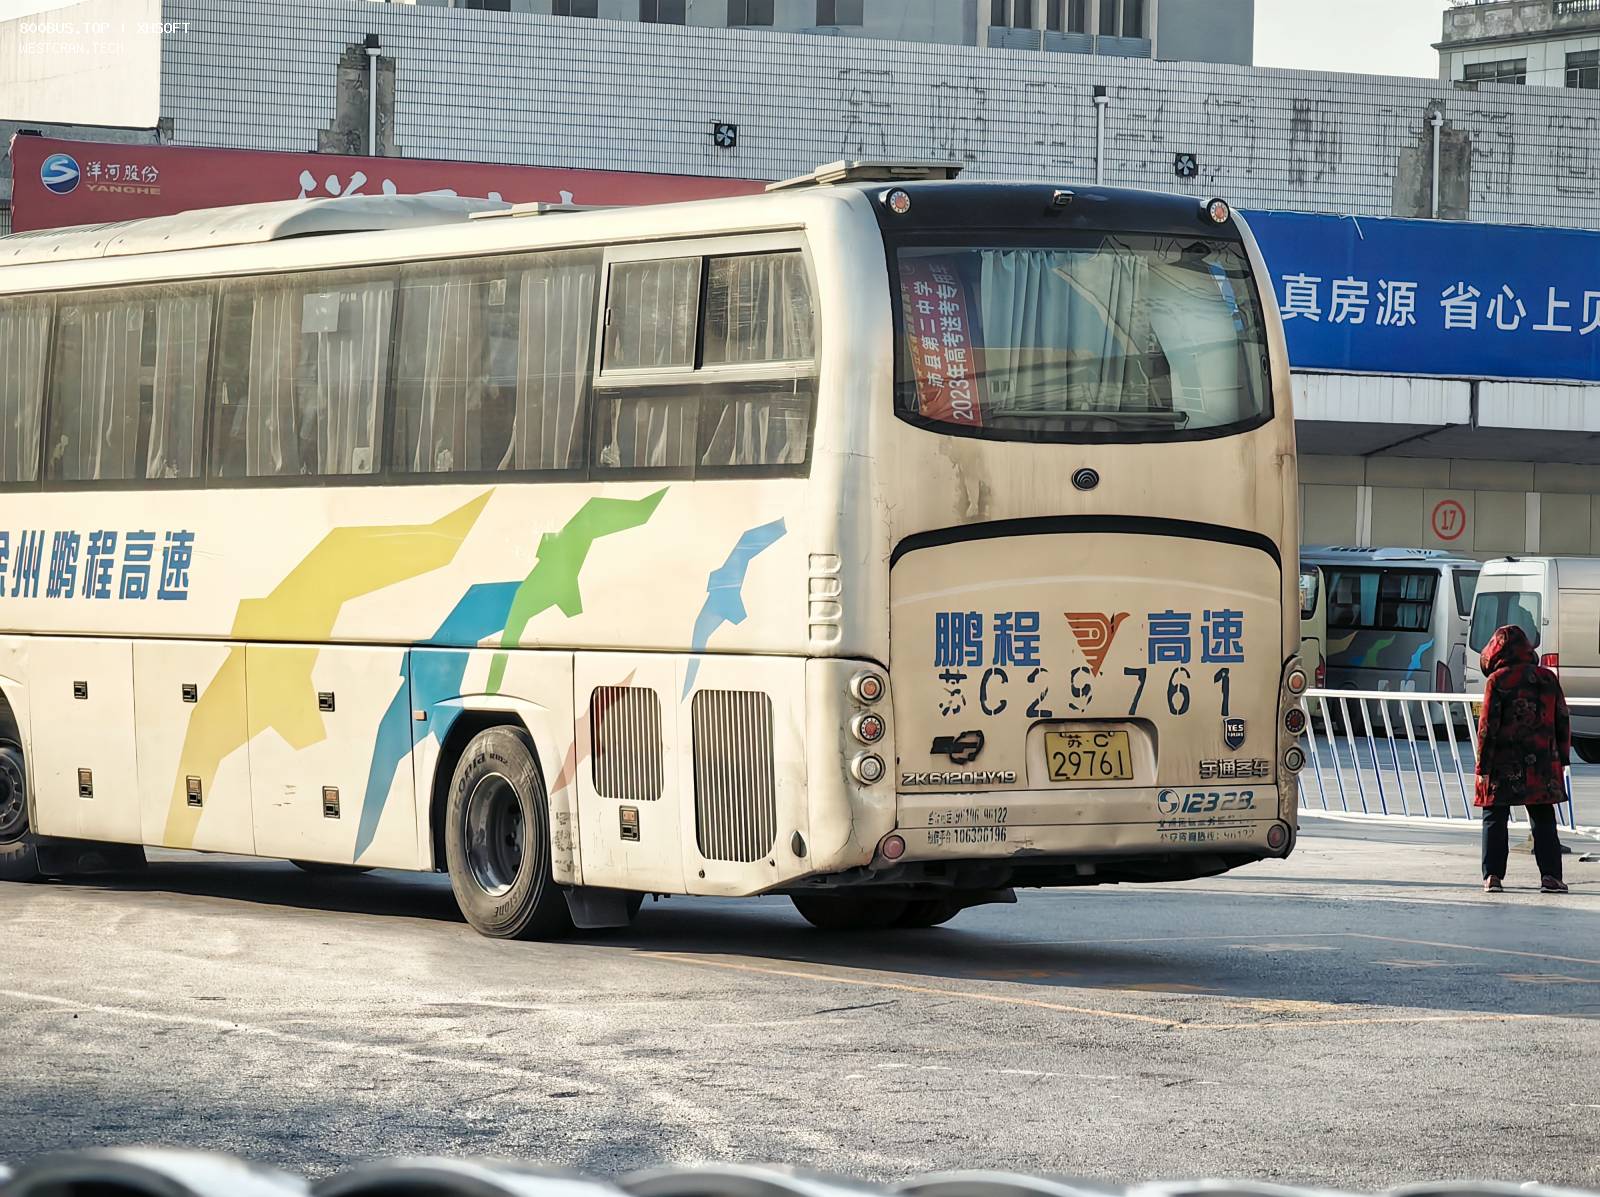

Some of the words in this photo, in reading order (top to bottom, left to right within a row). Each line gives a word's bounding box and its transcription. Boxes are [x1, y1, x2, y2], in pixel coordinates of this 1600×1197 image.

[86, 161, 159, 183] 洋河股份
[86, 184, 160, 195] YANGHE
[1280, 273, 1418, 327] 真房源
[1441, 510, 1457, 531] 17
[0, 530, 195, 600] 州鹏程高速
[934, 611, 1040, 667] 鹏程
[1147, 609, 1245, 664] 高速
[1053, 750, 1124, 777] 29761
[1200, 758, 1269, 779] 宇通客车
[902, 771, 1017, 786] ZK6120HY19
[1181, 790, 1254, 813] 12328
